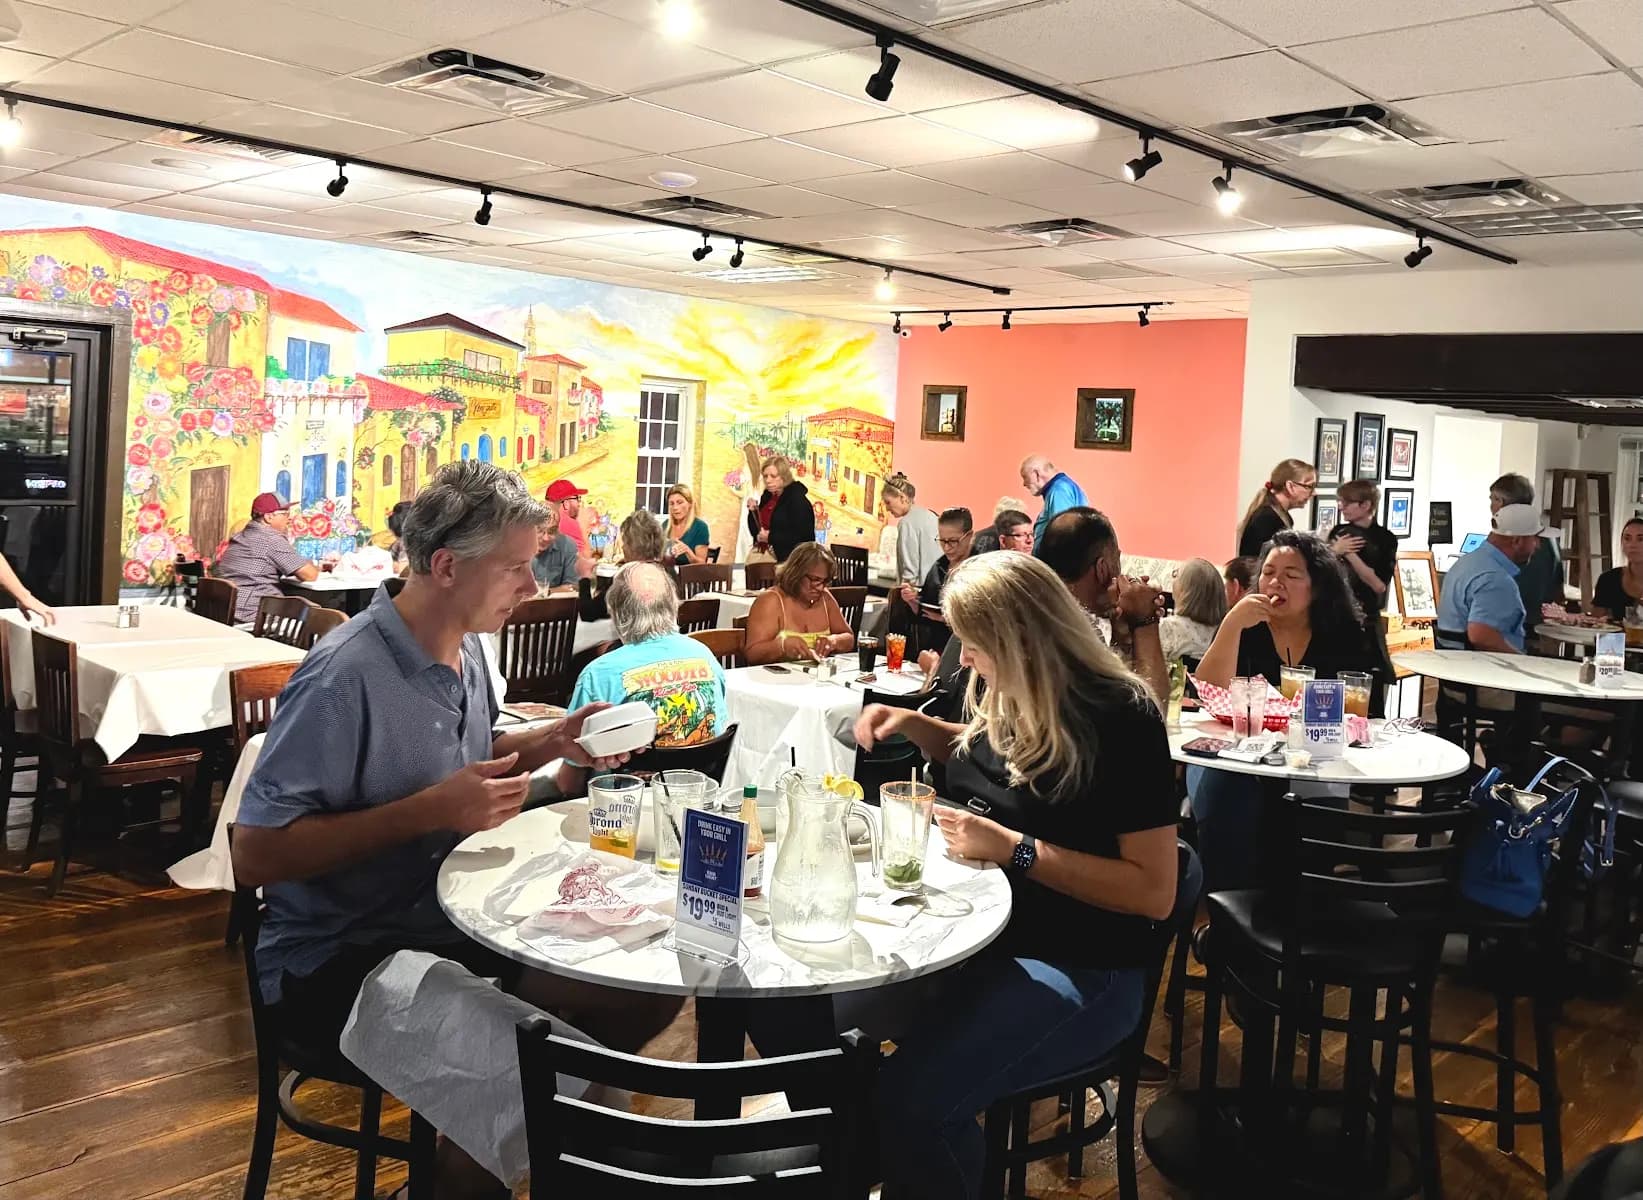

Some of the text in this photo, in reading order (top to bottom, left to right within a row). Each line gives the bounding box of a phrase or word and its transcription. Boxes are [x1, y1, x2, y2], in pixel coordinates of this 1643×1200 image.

[712, 823, 726, 834] EASY
[682, 882, 738, 905] SUNDAY BUCKET SPECIAL
